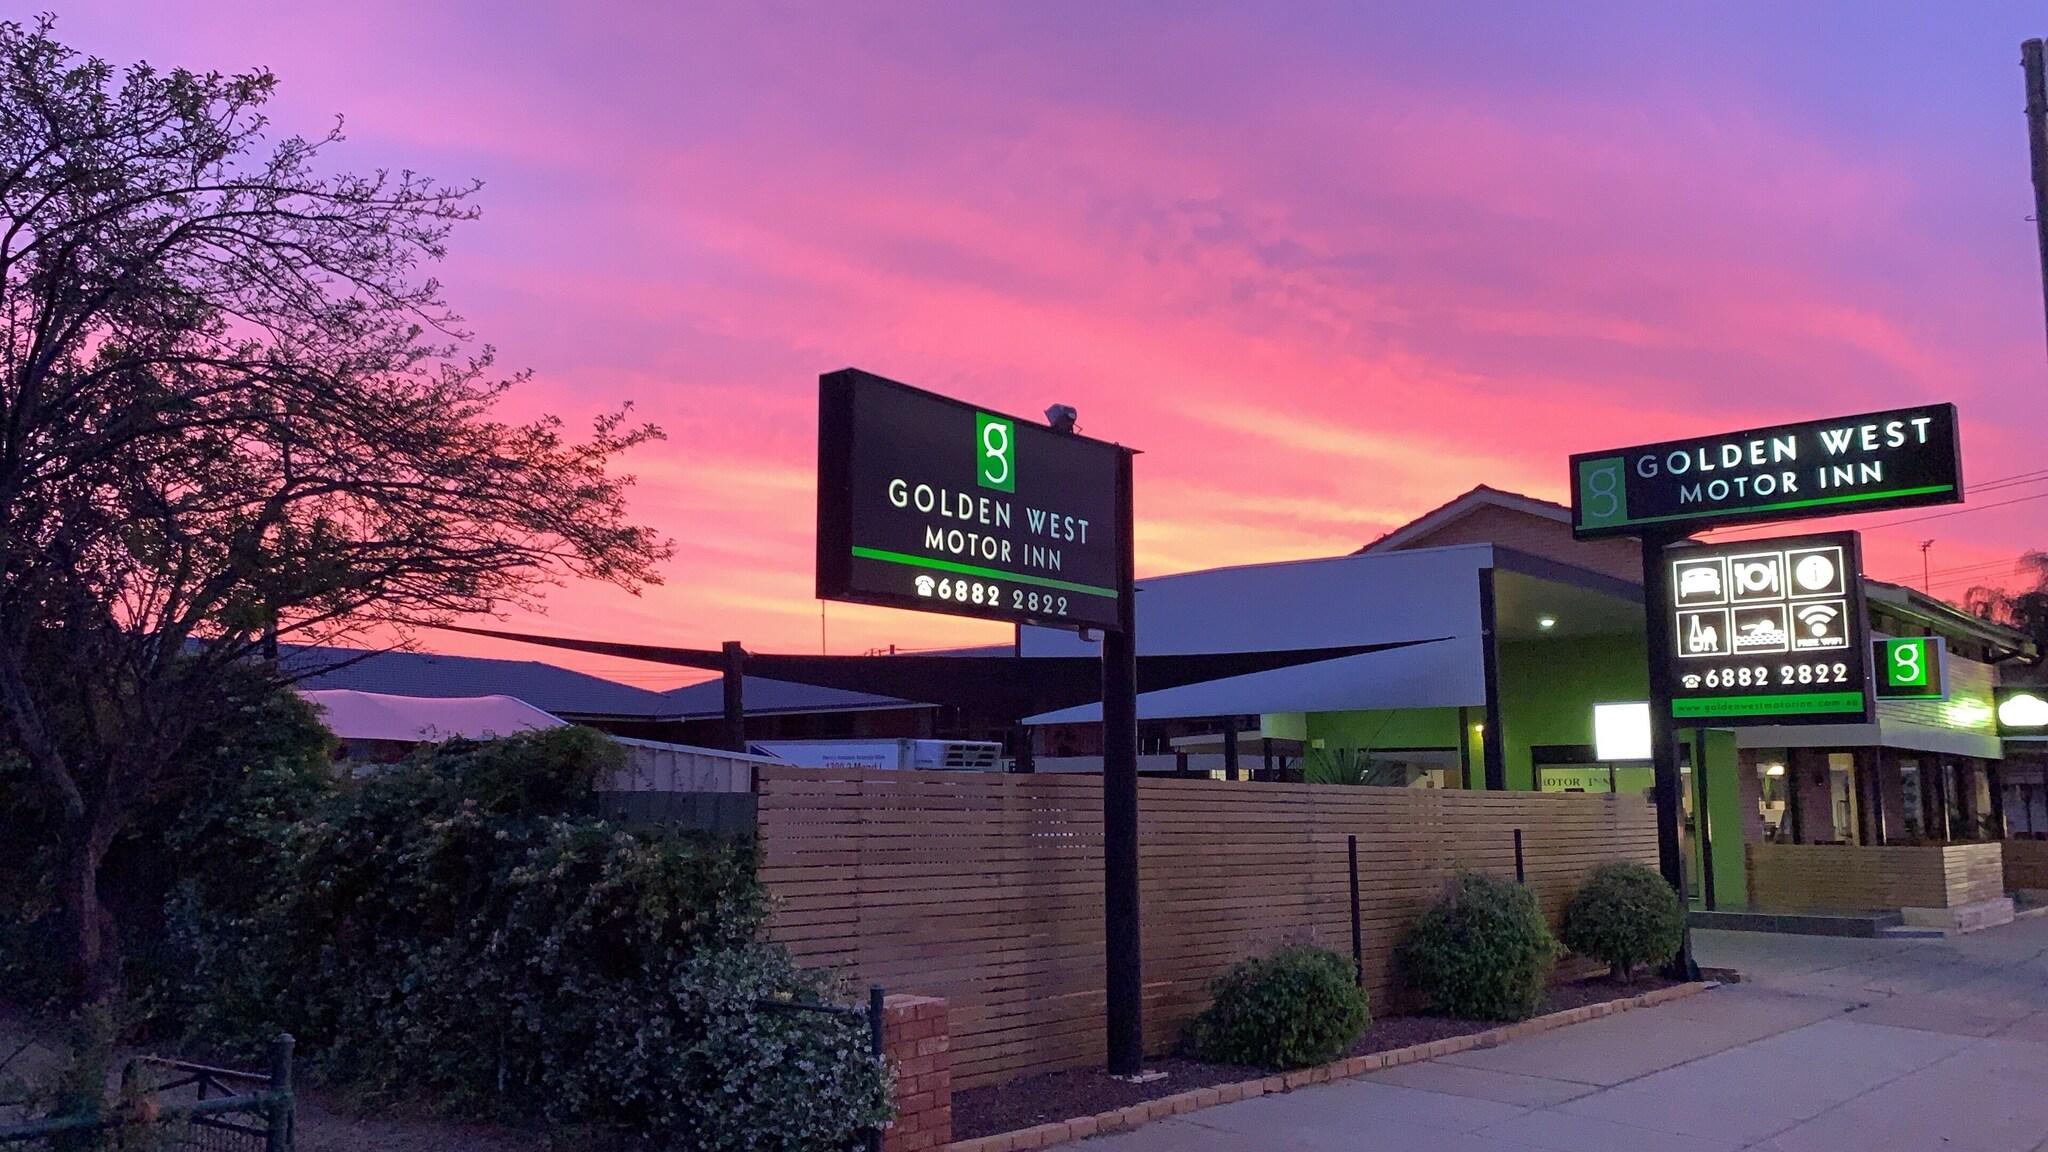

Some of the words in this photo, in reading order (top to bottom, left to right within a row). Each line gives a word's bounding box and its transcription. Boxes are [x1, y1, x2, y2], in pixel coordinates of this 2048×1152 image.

[1637, 435, 1797, 478] GOLDEN
[1820, 417, 1932, 455] WEST
[1680, 471, 1798, 504] MOTOR
[1819, 461, 1883, 489] INN
[889, 478, 1011, 529] GOLDEN
[1026, 507, 1089, 545] WEST
[925, 525, 1011, 563] MOTOR
[1024, 544, 1062, 571] INN
[938, 579, 1000, 606] 6882
[1013, 589, 1067, 616] 2822
[1705, 667, 1768, 688] 6882
[1781, 663, 1848, 685] 2822
